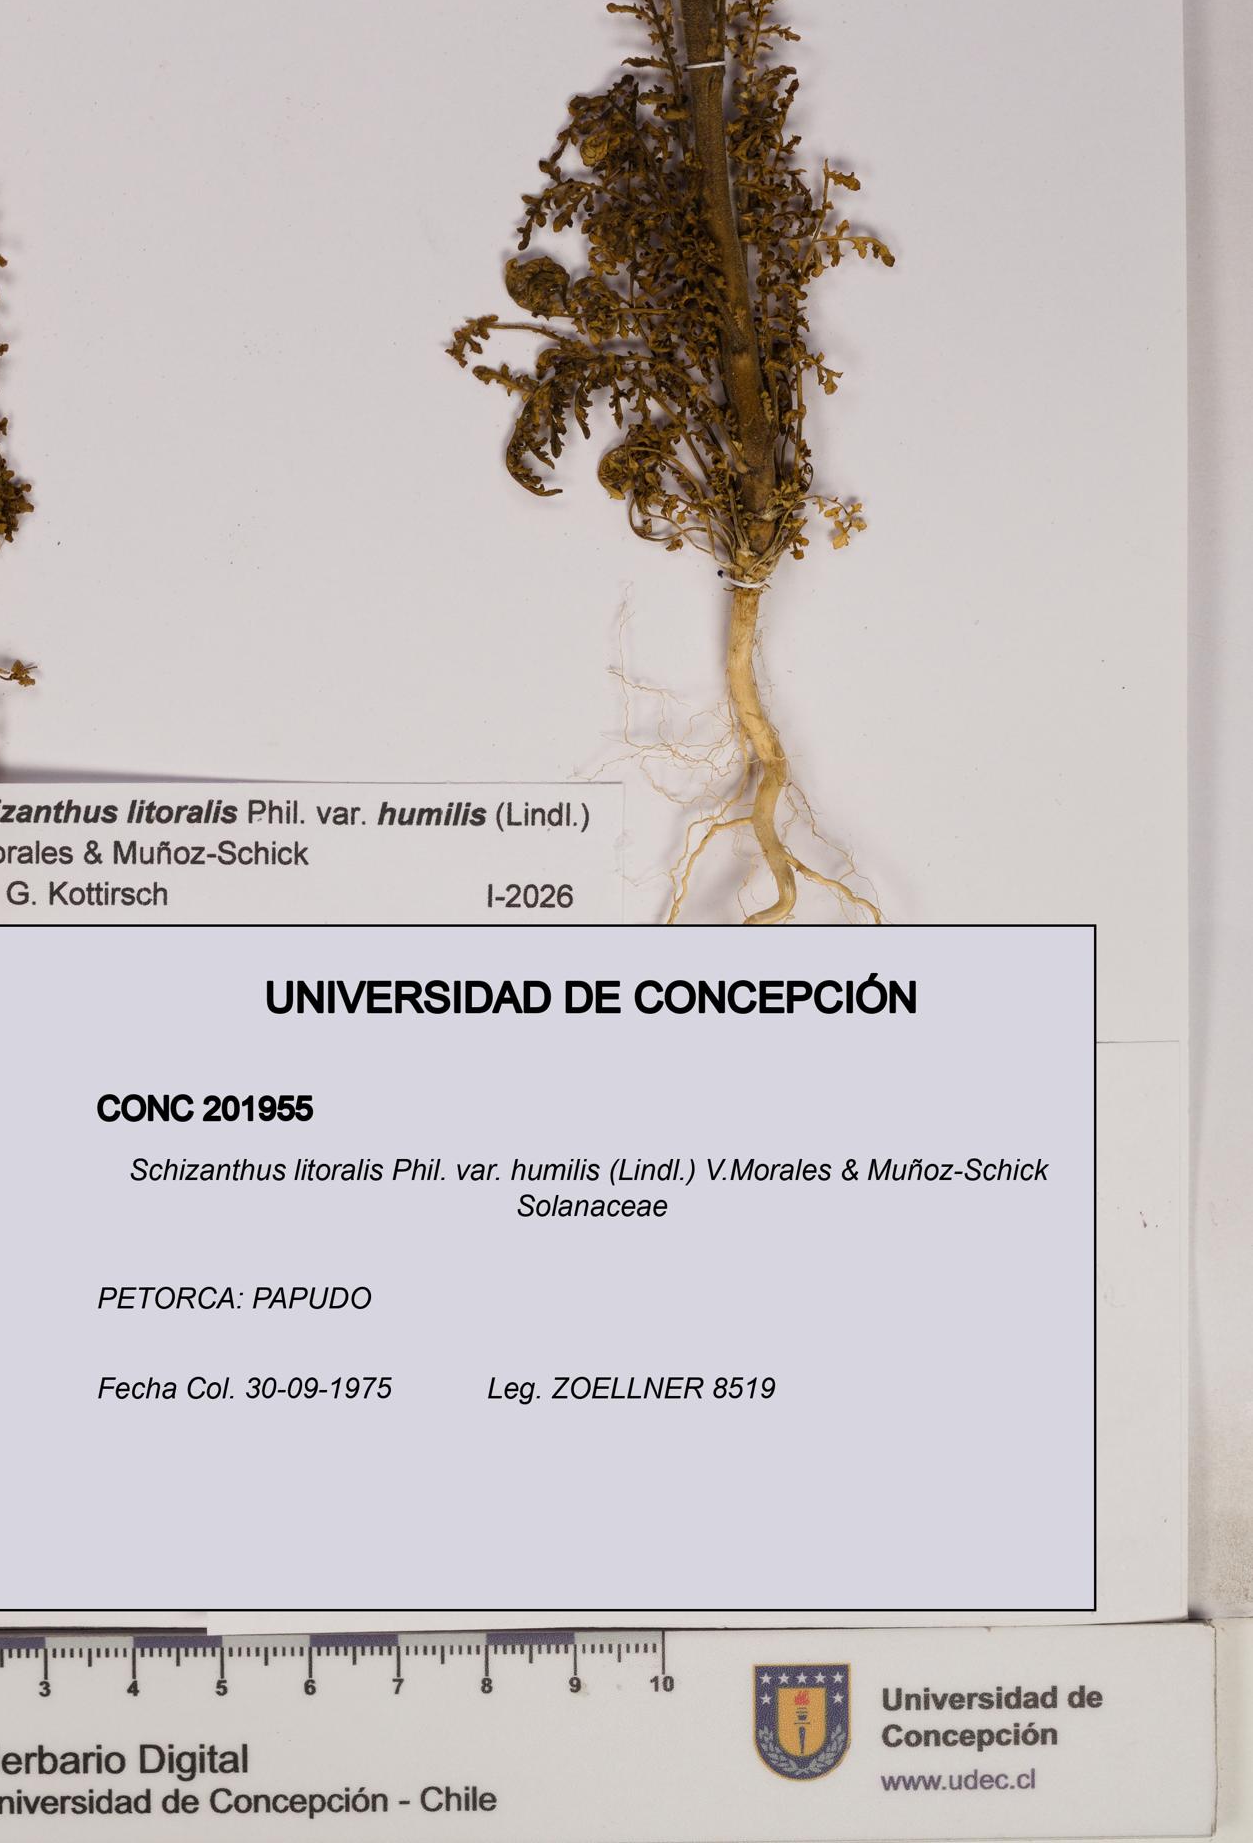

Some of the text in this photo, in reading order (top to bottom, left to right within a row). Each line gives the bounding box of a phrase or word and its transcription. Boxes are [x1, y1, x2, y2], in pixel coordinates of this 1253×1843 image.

[127, 800, 237, 824] litoralis
[249, 800, 304, 824] Phil.
[317, 806, 365, 825] var.
[378, 802, 486, 826] humilis
[496, 802, 589, 832] (Lindl.)
[84, 840, 102, 864] &
[114, 841, 308, 865] Muñoz-Schick
[7, 881, 36, 905] G.
[50, 881, 167, 906] Kottirsch
[488, 884, 573, 908] I-2026
[39, 1679, 51, 1697] 3
[127, 1680, 139, 1696] 4
[216, 1680, 227, 1696] 5
[304, 1679, 316, 1695] 6
[393, 1677, 404, 1694] 7
[481, 1678, 492, 1693] 8
[569, 1677, 581, 1692] 9
[650, 1676, 674, 1692] 10
[883, 1685, 1103, 1711] Universidad de
[882, 1723, 1057, 1752] Concepción
[140, 1744, 247, 1781] Digital
[881, 1768, 1035, 1791] www.udec.cl
[162, 1789, 199, 1814] de
[210, 1787, 388, 1819] Concepción
[421, 1786, 497, 1812] Chile
